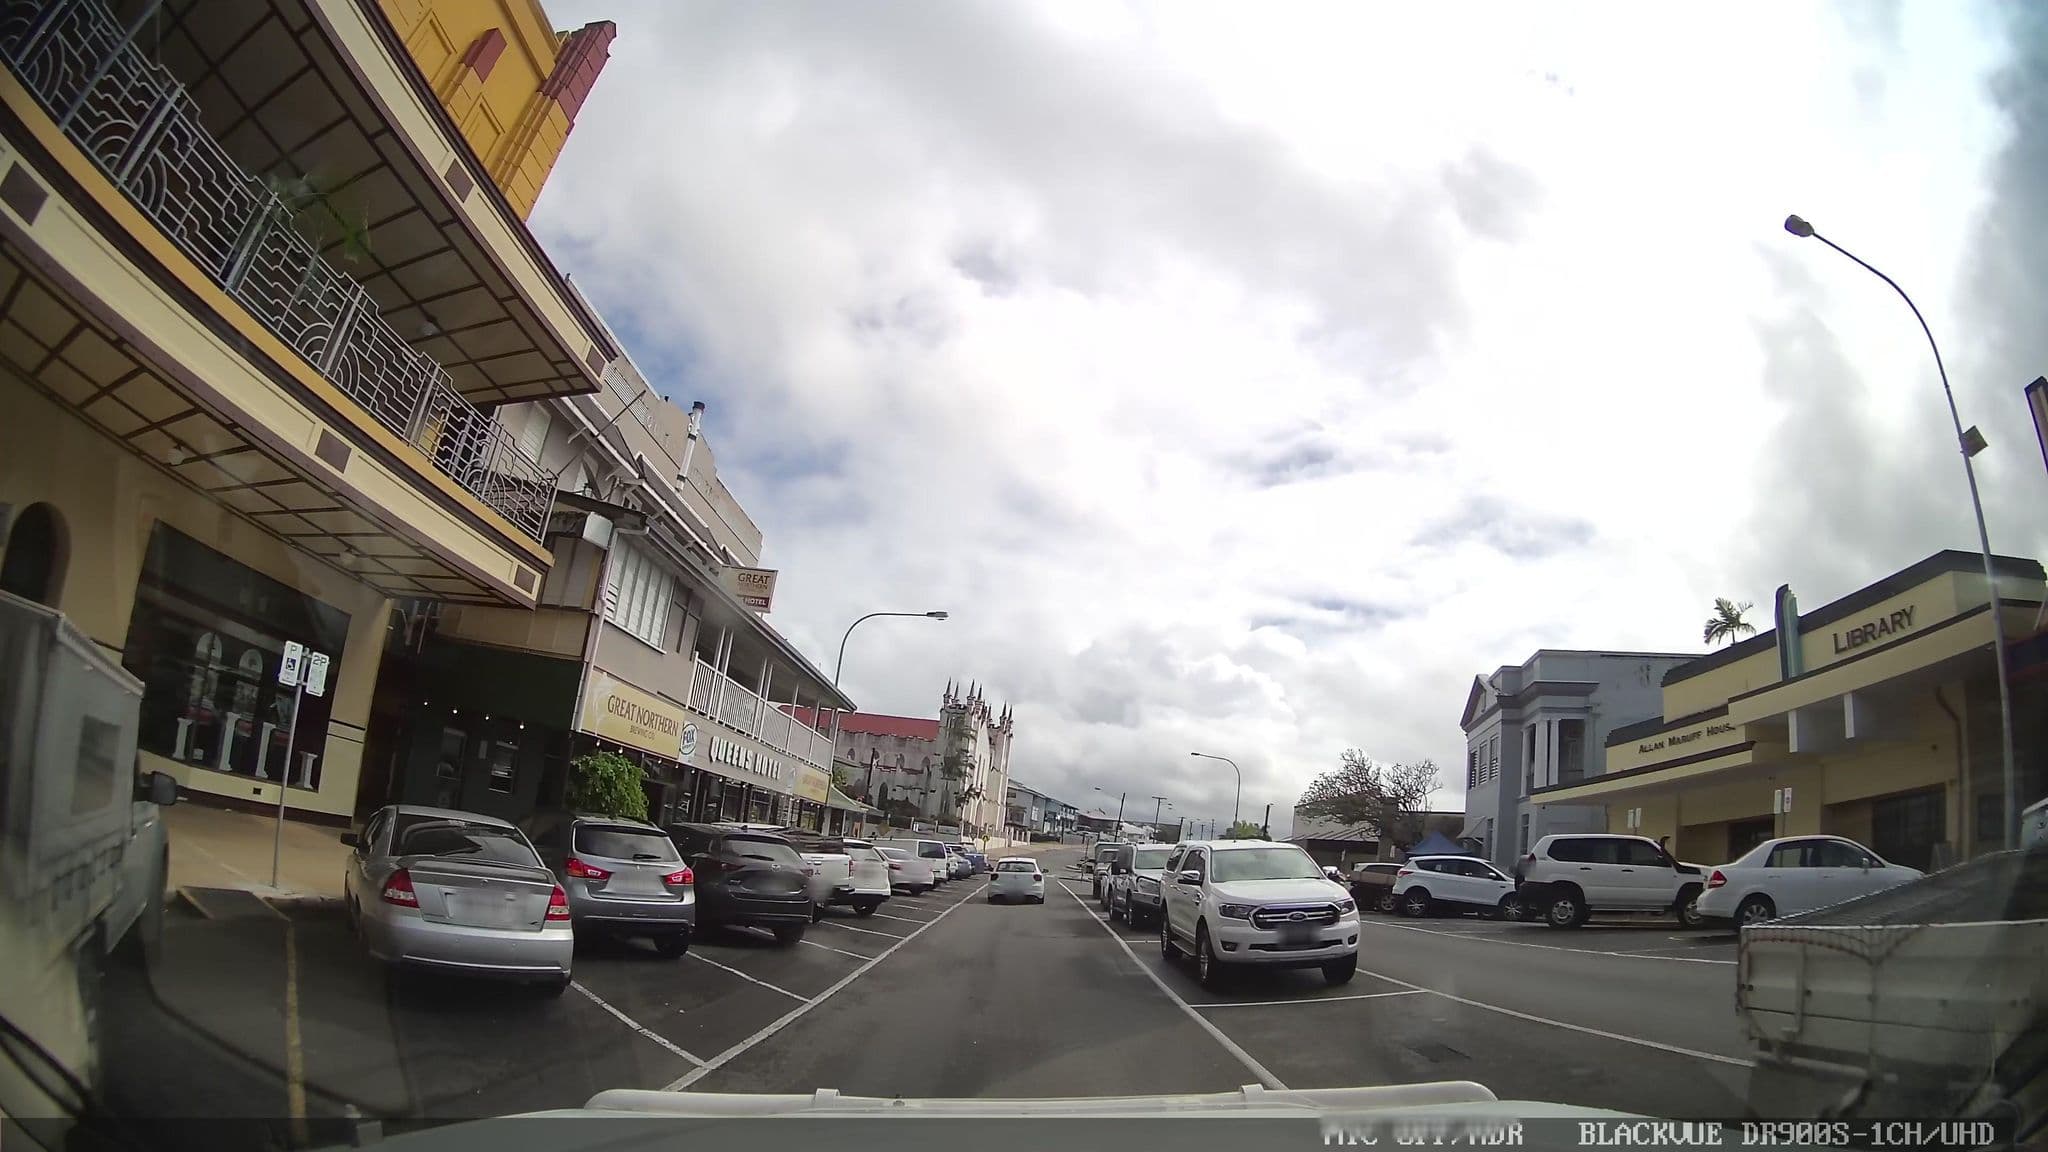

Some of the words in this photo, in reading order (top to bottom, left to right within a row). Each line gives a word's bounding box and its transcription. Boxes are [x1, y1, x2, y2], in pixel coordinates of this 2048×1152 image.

[738, 572, 770, 585] GREAT
[1832, 605, 1915, 655] LIBRARY
[312, 654, 328, 667] 2P
[607, 695, 637, 721] GREAT
[636, 706, 679, 736] NORTHERN
[682, 728, 696, 745] FOX
[1638, 741, 1665, 755] ALLAN
[709, 735, 753, 770] QUEENS
[753, 752, 781, 780] HOTEL
